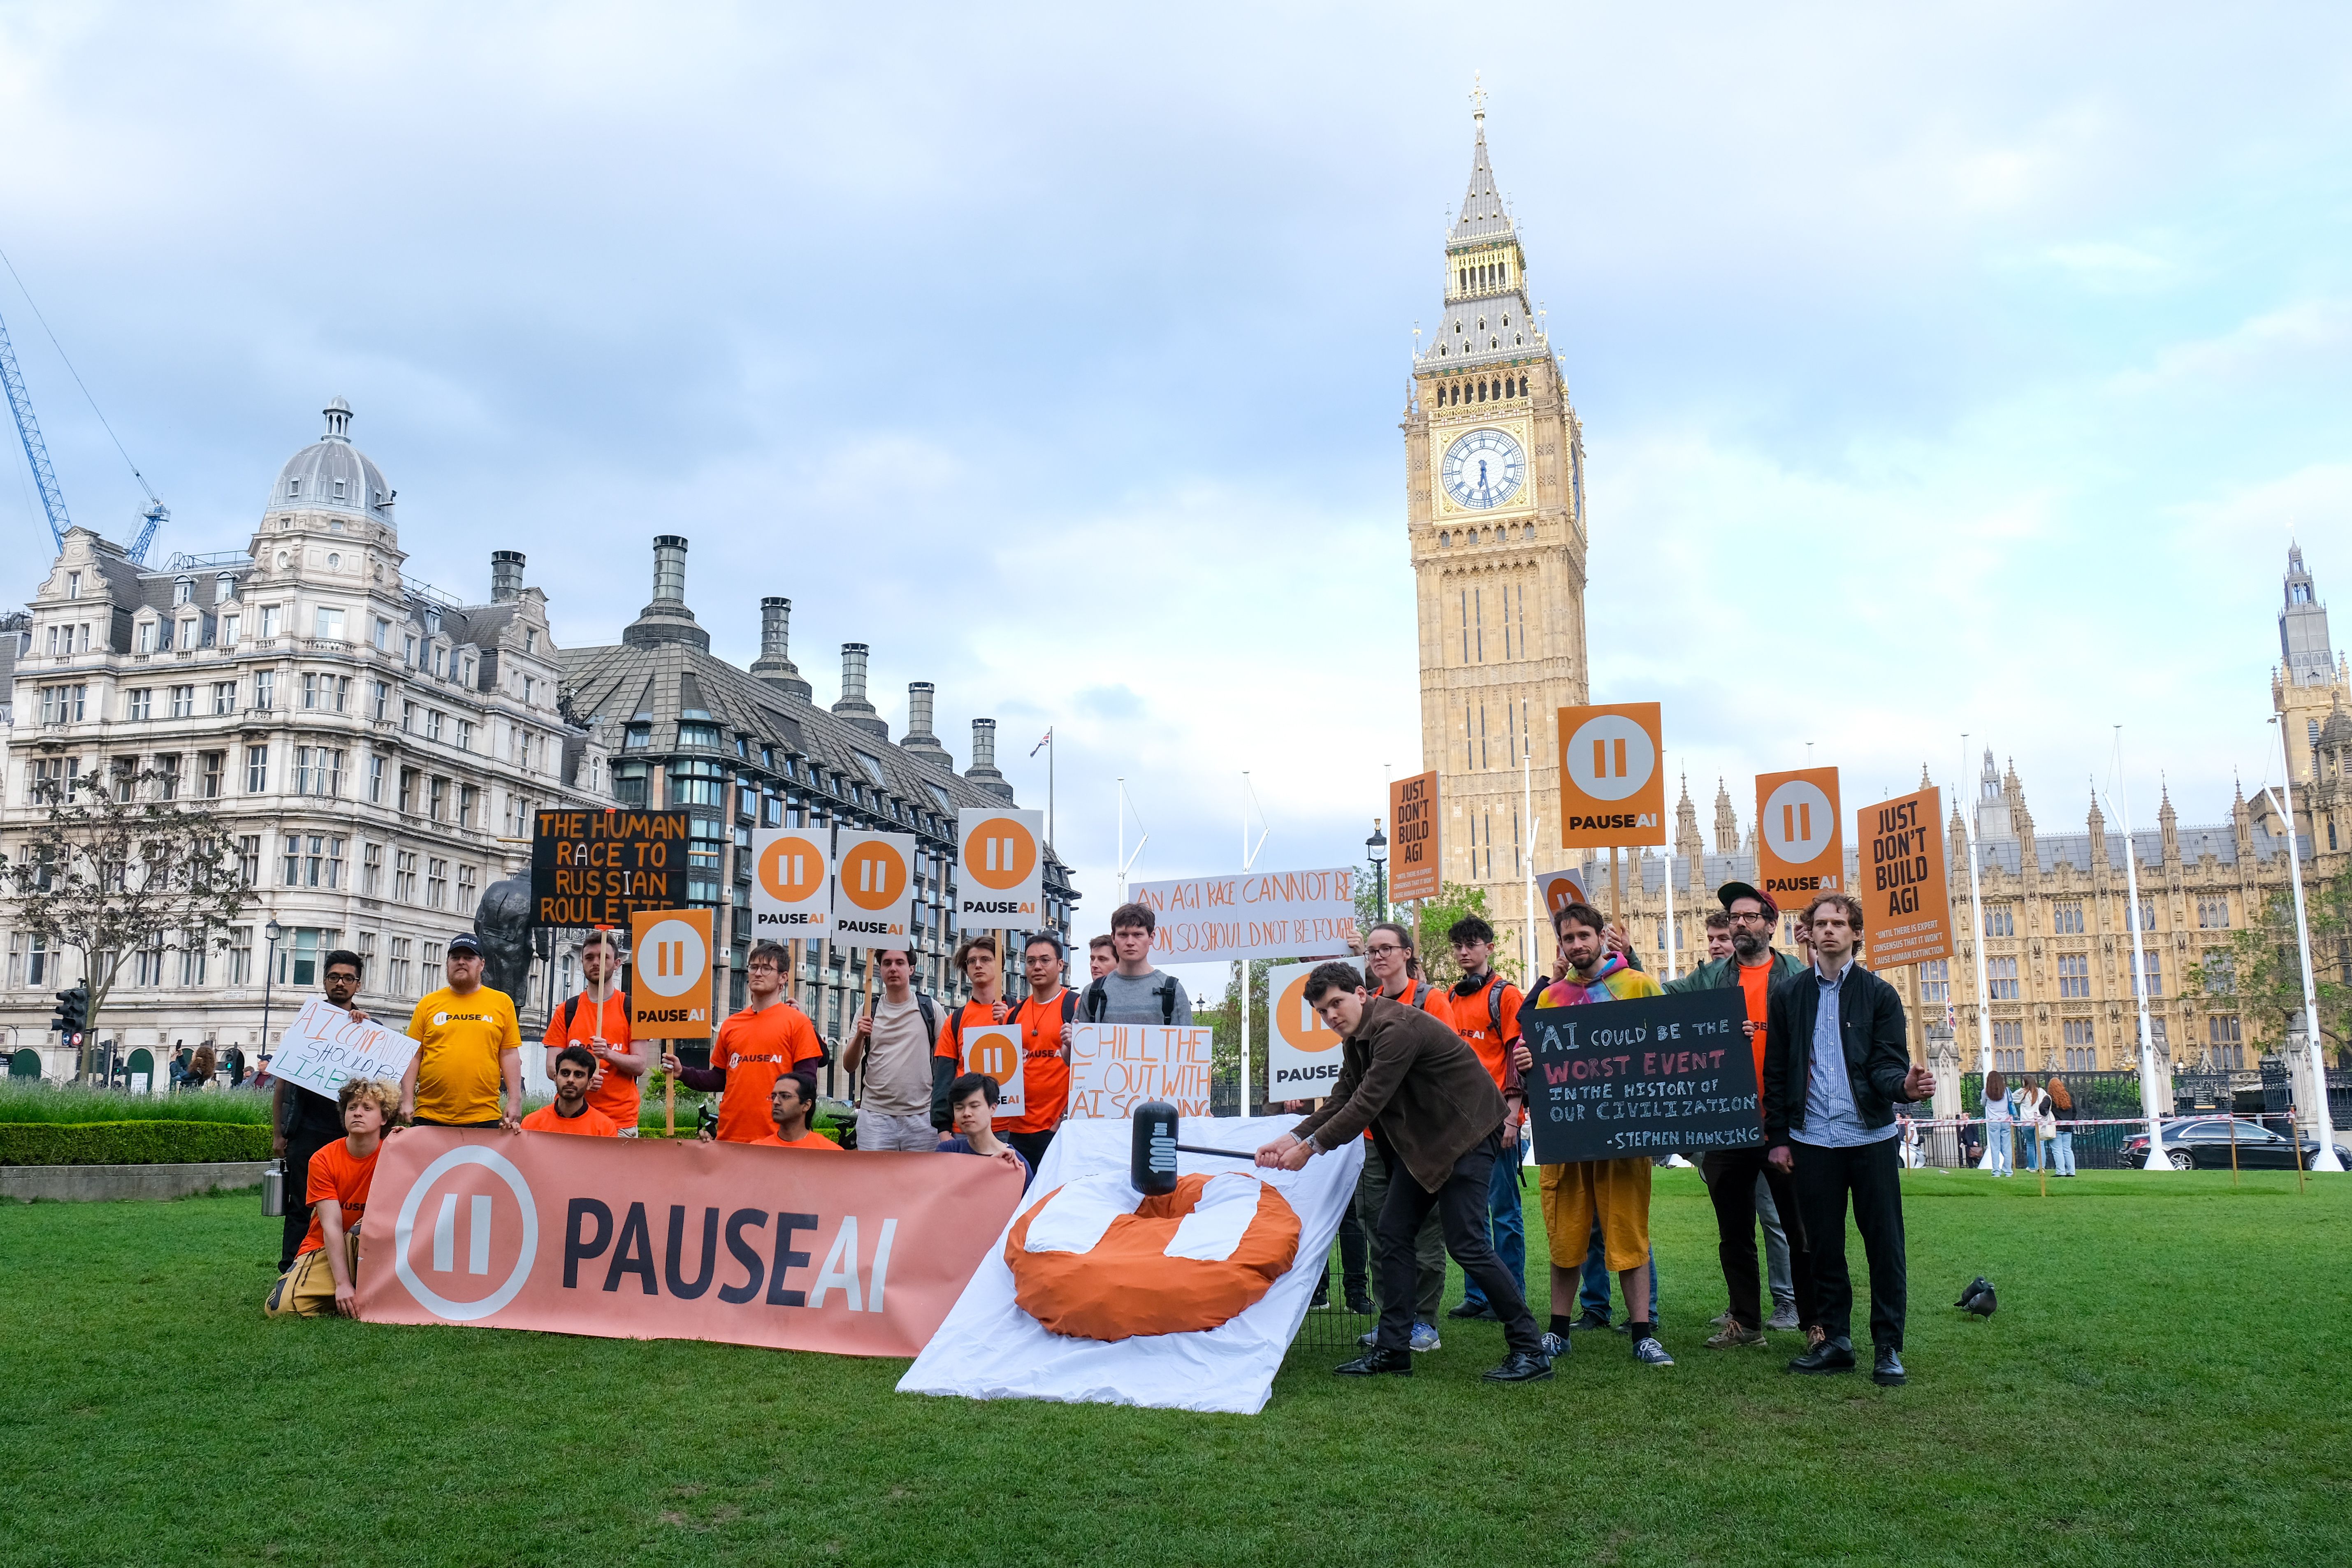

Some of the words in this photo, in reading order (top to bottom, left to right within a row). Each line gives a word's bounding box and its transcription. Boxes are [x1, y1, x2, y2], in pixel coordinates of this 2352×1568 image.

[1401, 779, 1425, 803] JUST
[1399, 799, 1429, 824] DON'T
[1570, 813, 1657, 830] PAUSEAI
[1878, 800, 1918, 835] JUST
[539, 813, 587, 838] THE
[591, 812, 685, 840] HUMAN
[1399, 820, 1429, 844] BUILD
[557, 841, 624, 867] RACE
[634, 841, 666, 868] TO
[1404, 842, 1422, 864] AGI
[1873, 826, 1926, 864] DON'T
[556, 870, 667, 896] RUSSIAN
[1766, 875, 1837, 892] PAUSEAI
[1876, 856, 1928, 891] BUILD
[1137, 888, 1163, 911] AN
[1171, 884, 1200, 912] AGI
[1206, 881, 1235, 907] RACE
[1243, 872, 1330, 903] CANNOT
[1335, 871, 1353, 901] BE
[1415, 886, 1434, 895] EXTINCTION
[1889, 886, 1919, 917] AGI
[758, 914, 824, 924] PAUSEAI
[963, 901, 1035, 914] PAUSEAI
[838, 920, 903, 935] PAUSEAI
[1152, 925, 1174, 955] ON,
[1177, 923, 1199, 952] SO
[1201, 921, 1261, 952] SHOULD
[1263, 920, 1289, 946] NOT
[1294, 919, 1312, 943] BE
[1893, 925, 1910, 935] THERE
[1911, 924, 1916, 932] IS
[1917, 920, 1938, 931] EXPERT
[1873, 940, 1903, 952] CONSENSUS
[1903, 937, 1918, 946] THAT
[1924, 932, 1943, 943] WON'T
[1874, 955, 1891, 965] CAUSE
[1892, 951, 1911, 962] HUMAN
[1912, 945, 1944, 958] EXTINCTION
[446, 1014, 493, 1023] PAUSEAI
[638, 1009, 705, 1023] PAUSEAI
[294, 1002, 345, 1040] AI
[335, 1022, 418, 1069] COMPANIES
[1073, 1025, 1158, 1062] CHILL
[1160, 1028, 1210, 1063] THE
[1591, 1027, 1646, 1046] COULD
[1657, 1023, 1682, 1041] BE
[1692, 1019, 1729, 1036] THE
[302, 1041, 373, 1072] SHOULD
[738, 1054, 782, 1063] PAUSEAI
[1026, 1049, 1062, 1058] PAUSEA
[276, 1051, 348, 1090] LIAB
[1277, 1064, 1338, 1083] PAUSE
[1542, 1055, 1631, 1084] WORST
[1643, 1049, 1726, 1075] EVENT
[1104, 1062, 1158, 1094] OUT
[1162, 1065, 1211, 1097] WITH
[1549, 1087, 1577, 1101] IN
[1579, 1083, 1612, 1099] THE
[1624, 1081, 1696, 1098] HISTORY
[1700, 1079, 1719, 1093] OF
[1069, 1090, 1105, 1119] AI
[1111, 1095, 1209, 1119] SCING
[1550, 1104, 1586, 1122] OUR
[1686, 1126, 1760, 1145] HAWKING
[1148, 1137, 1177, 1174] 1000
[563, 1197, 898, 1313] PAUSEAI
